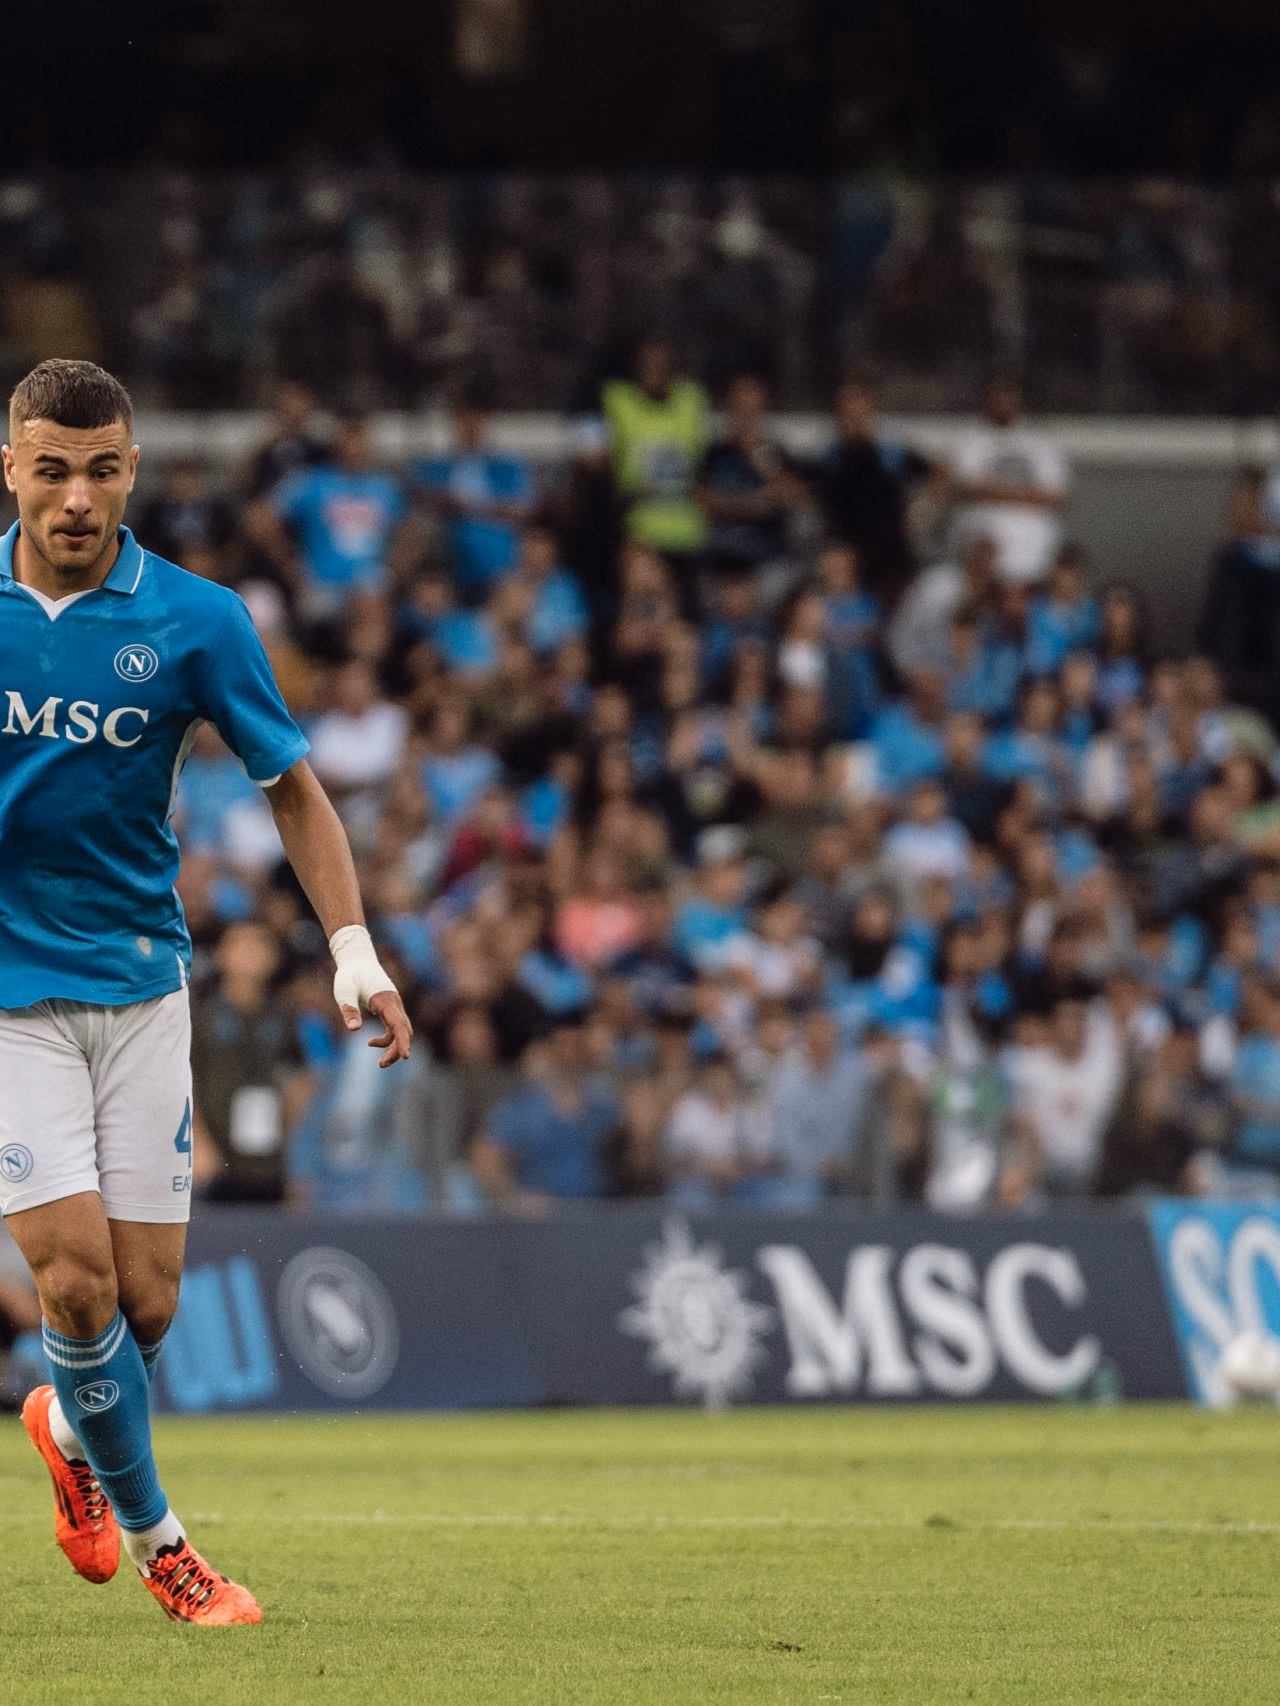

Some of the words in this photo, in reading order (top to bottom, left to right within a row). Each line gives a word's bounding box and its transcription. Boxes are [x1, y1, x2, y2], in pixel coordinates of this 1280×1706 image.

[126, 654, 146, 673] N
[1, 690, 149, 747] MSC
[174, 1096, 191, 1168] 4
[4, 1152, 21, 1174] N
[756, 1243, 1101, 1395] MSC
[87, 1386, 107, 1405] N
